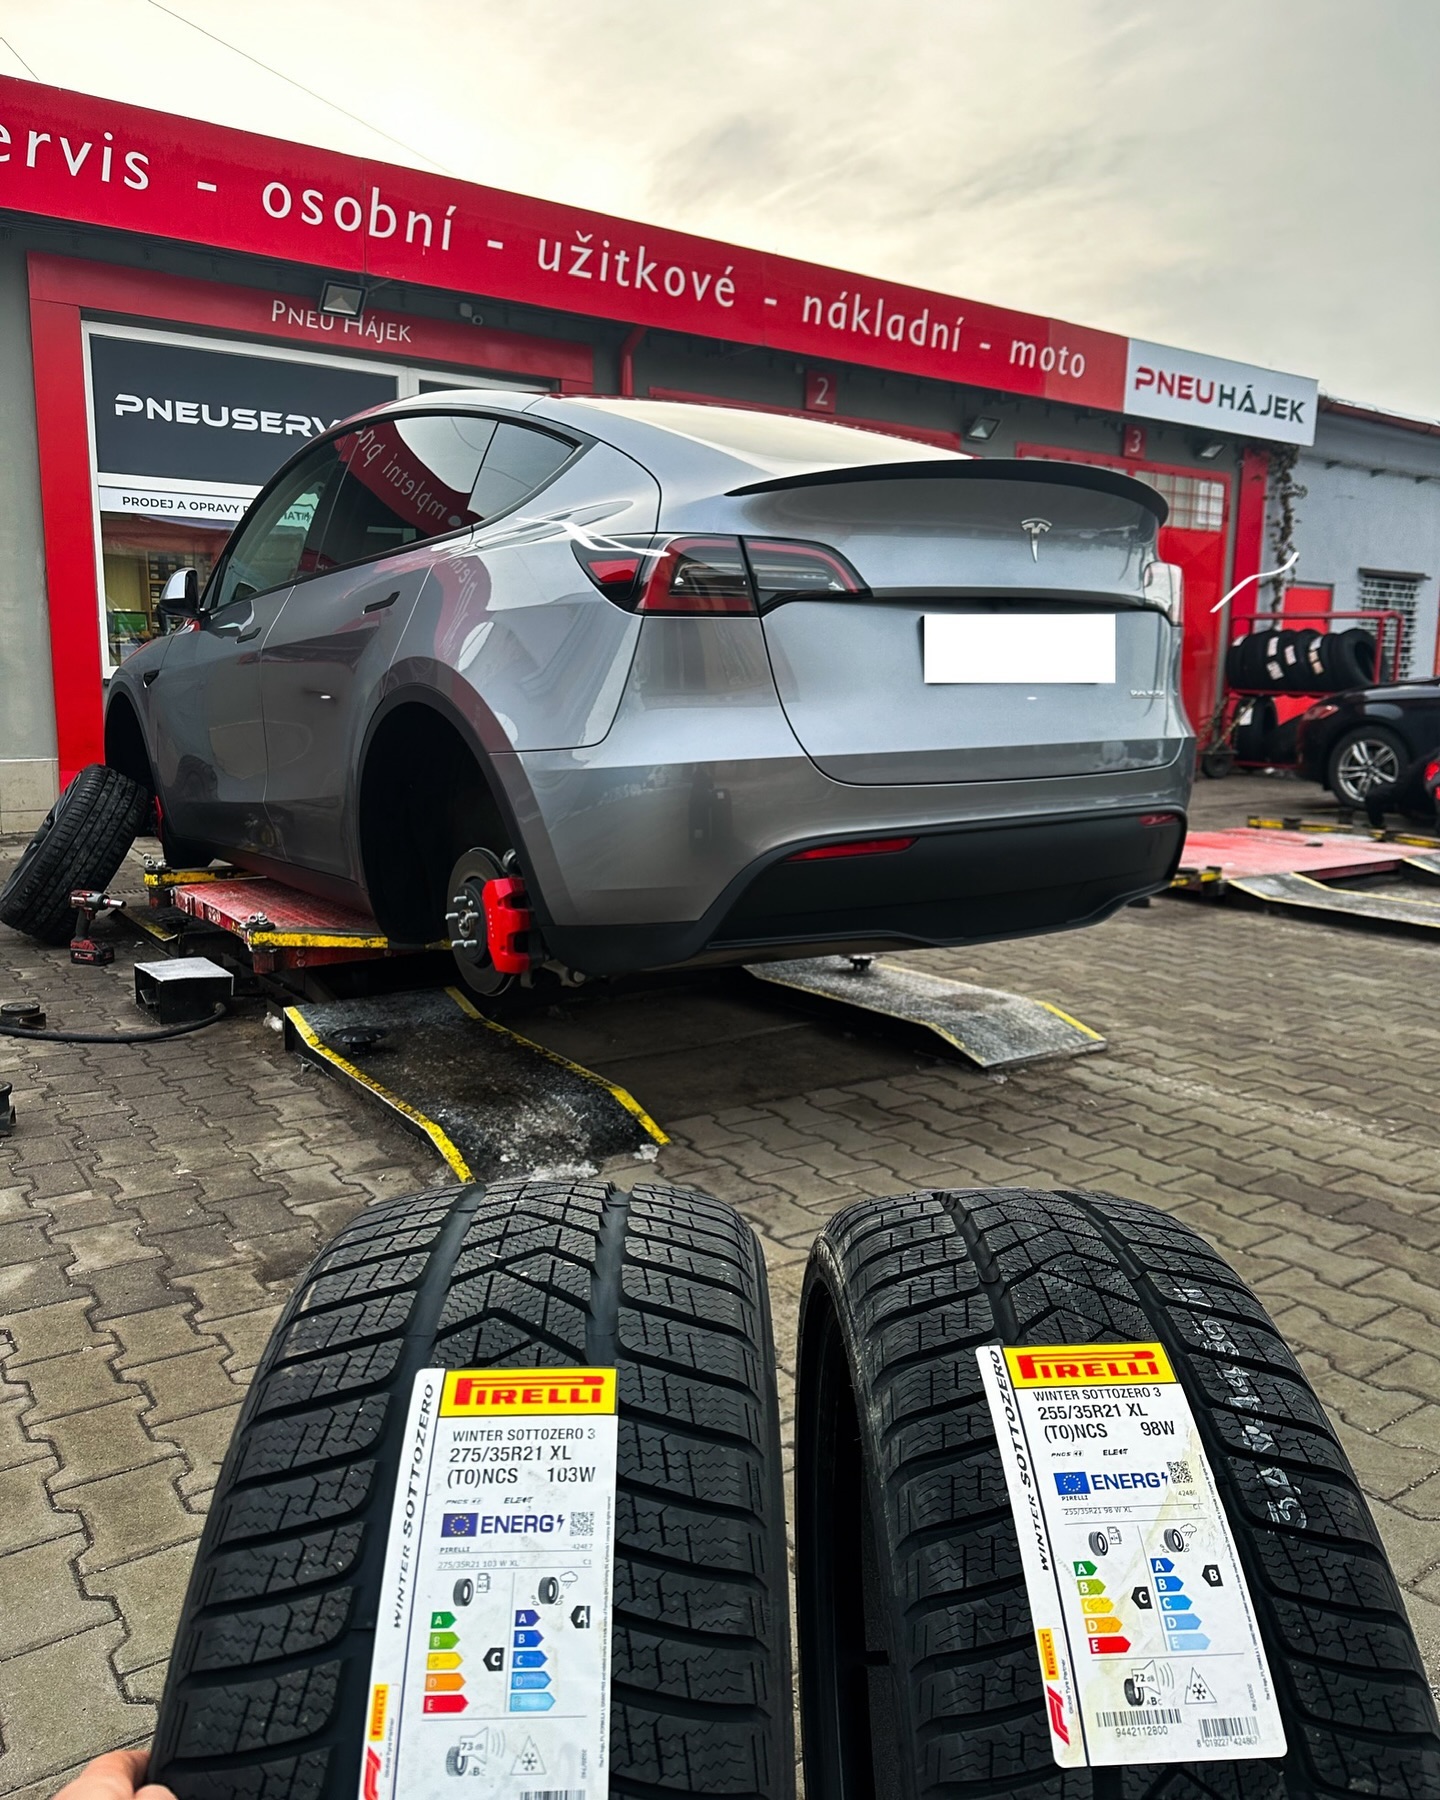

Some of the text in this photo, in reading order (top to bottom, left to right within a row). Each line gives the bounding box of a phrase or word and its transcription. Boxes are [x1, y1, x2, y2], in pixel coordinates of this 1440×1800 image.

[261, 181, 457, 251] osobní
[537, 229, 736, 308] užitkové
[802, 290, 965, 353] nákladní
[1009, 339, 1087, 379] moto
[271, 299, 334, 331] PNEU
[815, 377, 829, 406] 2
[1130, 430, 1142, 453] 3
[122, 495, 174, 509] PRODEJ
[176, 500, 187, 510] A
[191, 501, 240, 514] OPRAVY
[1016, 1350, 1160, 1380] PIRELLI
[453, 1375, 605, 1406] PIRELLI
[1033, 1387, 1162, 1402] WINTER SOTTOZERO 3
[1037, 1402, 1149, 1420] 255/35R21 XL
[1140, 1420, 1175, 1436] 98W
[452, 1428, 596, 1442] WINTER SOTTOZERO 3
[449, 1445, 572, 1463] 275/35R21 XL
[989, 1350, 1049, 1571] WINTER SOTTOZERO
[547, 1466, 596, 1483] 103W
[392, 1383, 434, 1629] WINTER SOTTOZERO
[1077, 1564, 1087, 1575] A
[1155, 1560, 1165, 1571] A
[1208, 1569, 1219, 1581] B
[1079, 1582, 1089, 1594] B
[1158, 1579, 1167, 1590] B
[1138, 1592, 1148, 1604] C
[1162, 1598, 1172, 1609] C
[434, 1615, 443, 1625] A
[519, 1613, 527, 1624] A
[577, 1611, 588, 1623] A
[1166, 1617, 1177, 1628] D
[1087, 1620, 1098, 1632] D
[518, 1633, 526, 1644] B
[1171, 1638, 1180, 1649] E
[1091, 1640, 1100, 1652] E
[490, 1652, 501, 1666] C
[516, 1654, 523, 1665] C
[1134, 1673, 1146, 1682] 72
[426, 1699, 434, 1711] E
[1115, 1725, 1169, 1737] 9442112800
[460, 1742, 474, 1751] 73
